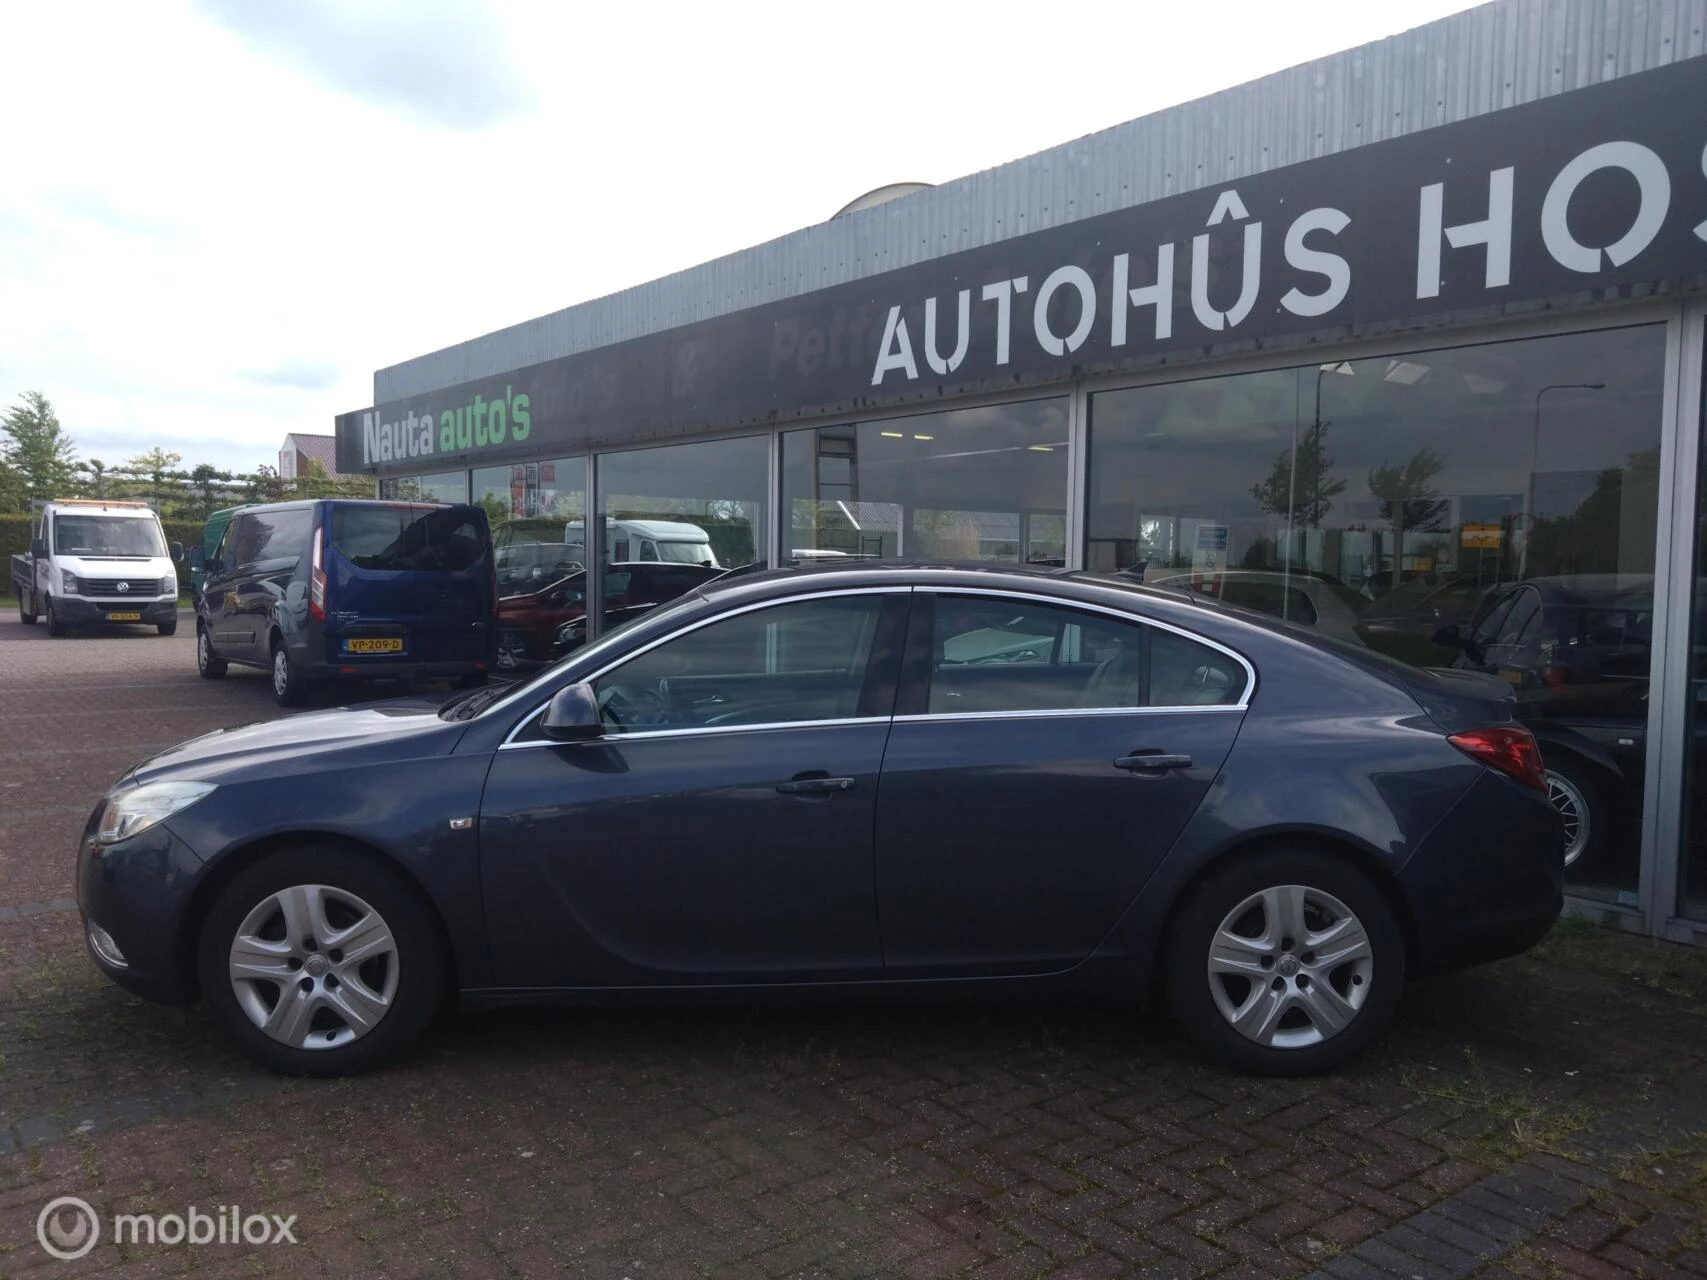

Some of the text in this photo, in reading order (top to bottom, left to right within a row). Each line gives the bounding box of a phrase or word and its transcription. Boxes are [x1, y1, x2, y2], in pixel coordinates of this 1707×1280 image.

[870, 139, 1707, 387] AUTOHÛS HO
[363, 410, 434, 464] Nauta
[439, 384, 531, 452] auto's
[351, 640, 400, 650] VP-209-D
